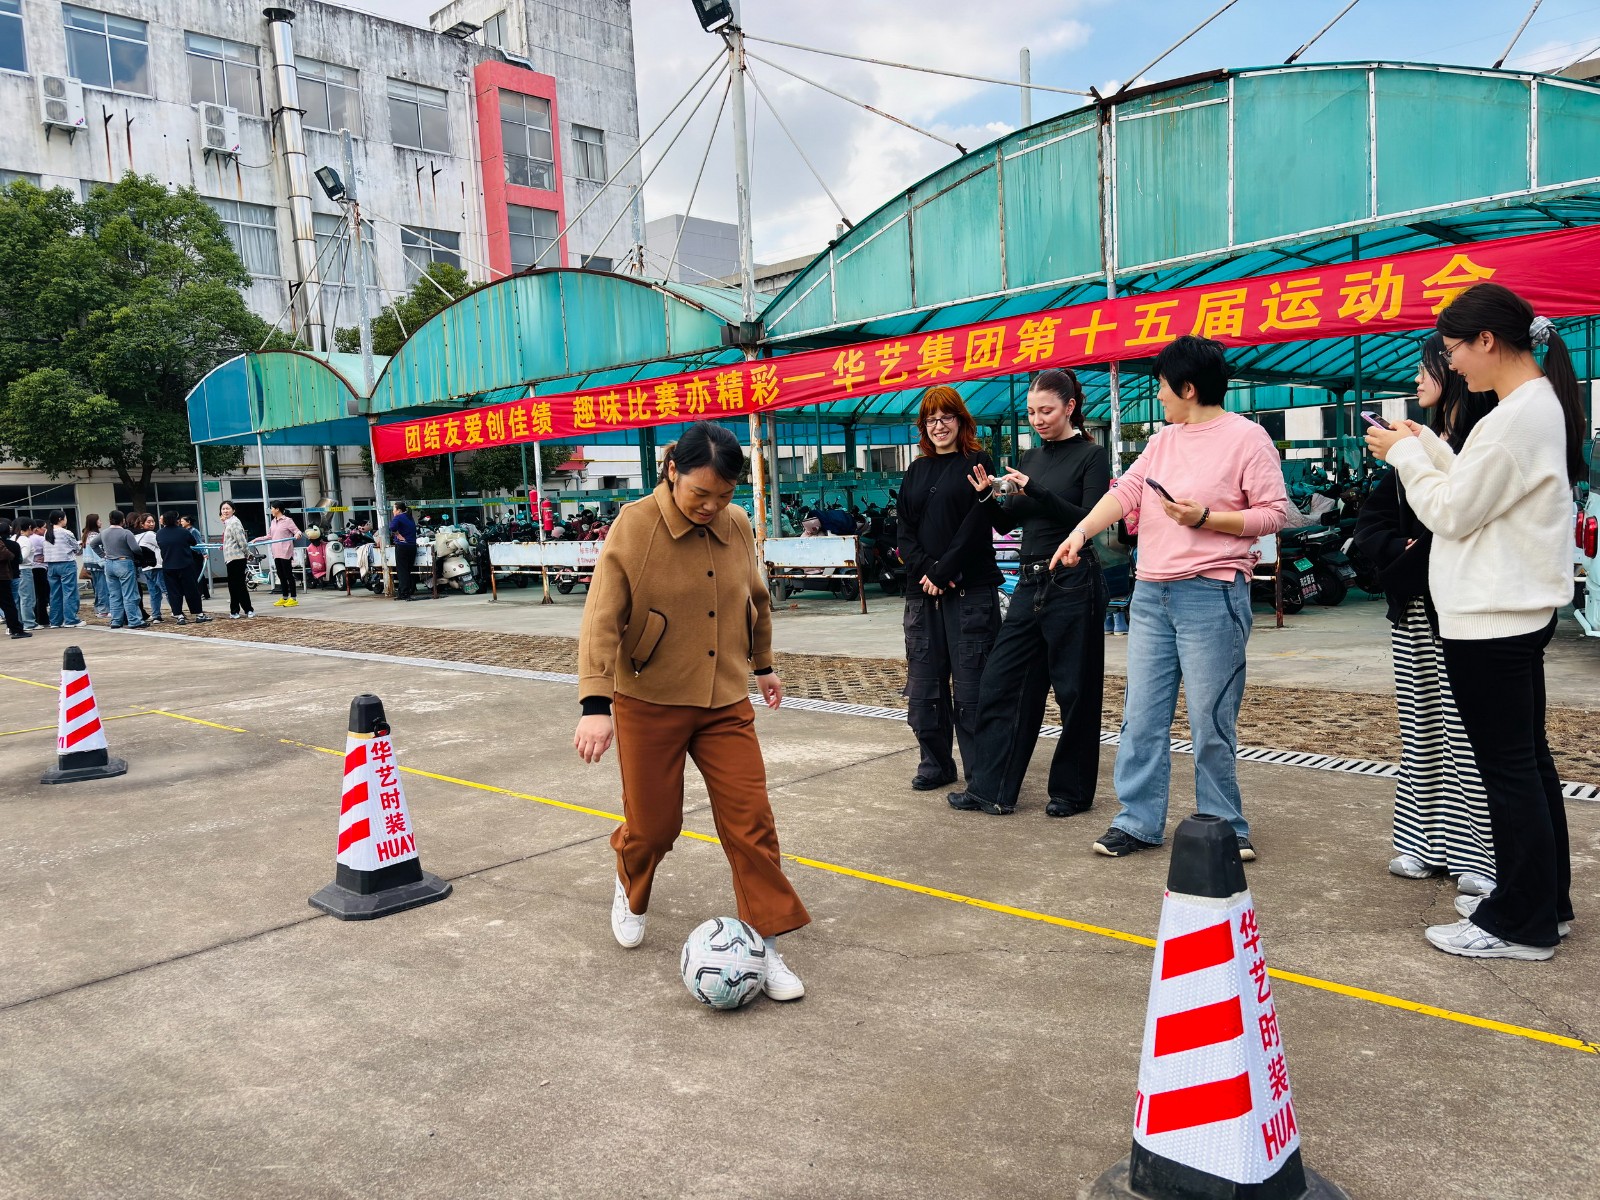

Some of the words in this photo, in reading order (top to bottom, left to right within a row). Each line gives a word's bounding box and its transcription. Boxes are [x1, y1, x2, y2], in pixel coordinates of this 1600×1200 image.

[405, 401, 553, 454] 团结友爱创佳绩
[370, 740, 407, 835] 华艺时装
[1239, 908, 1290, 1102] 华艺时装
[1261, 1097, 1297, 1162] HUA
